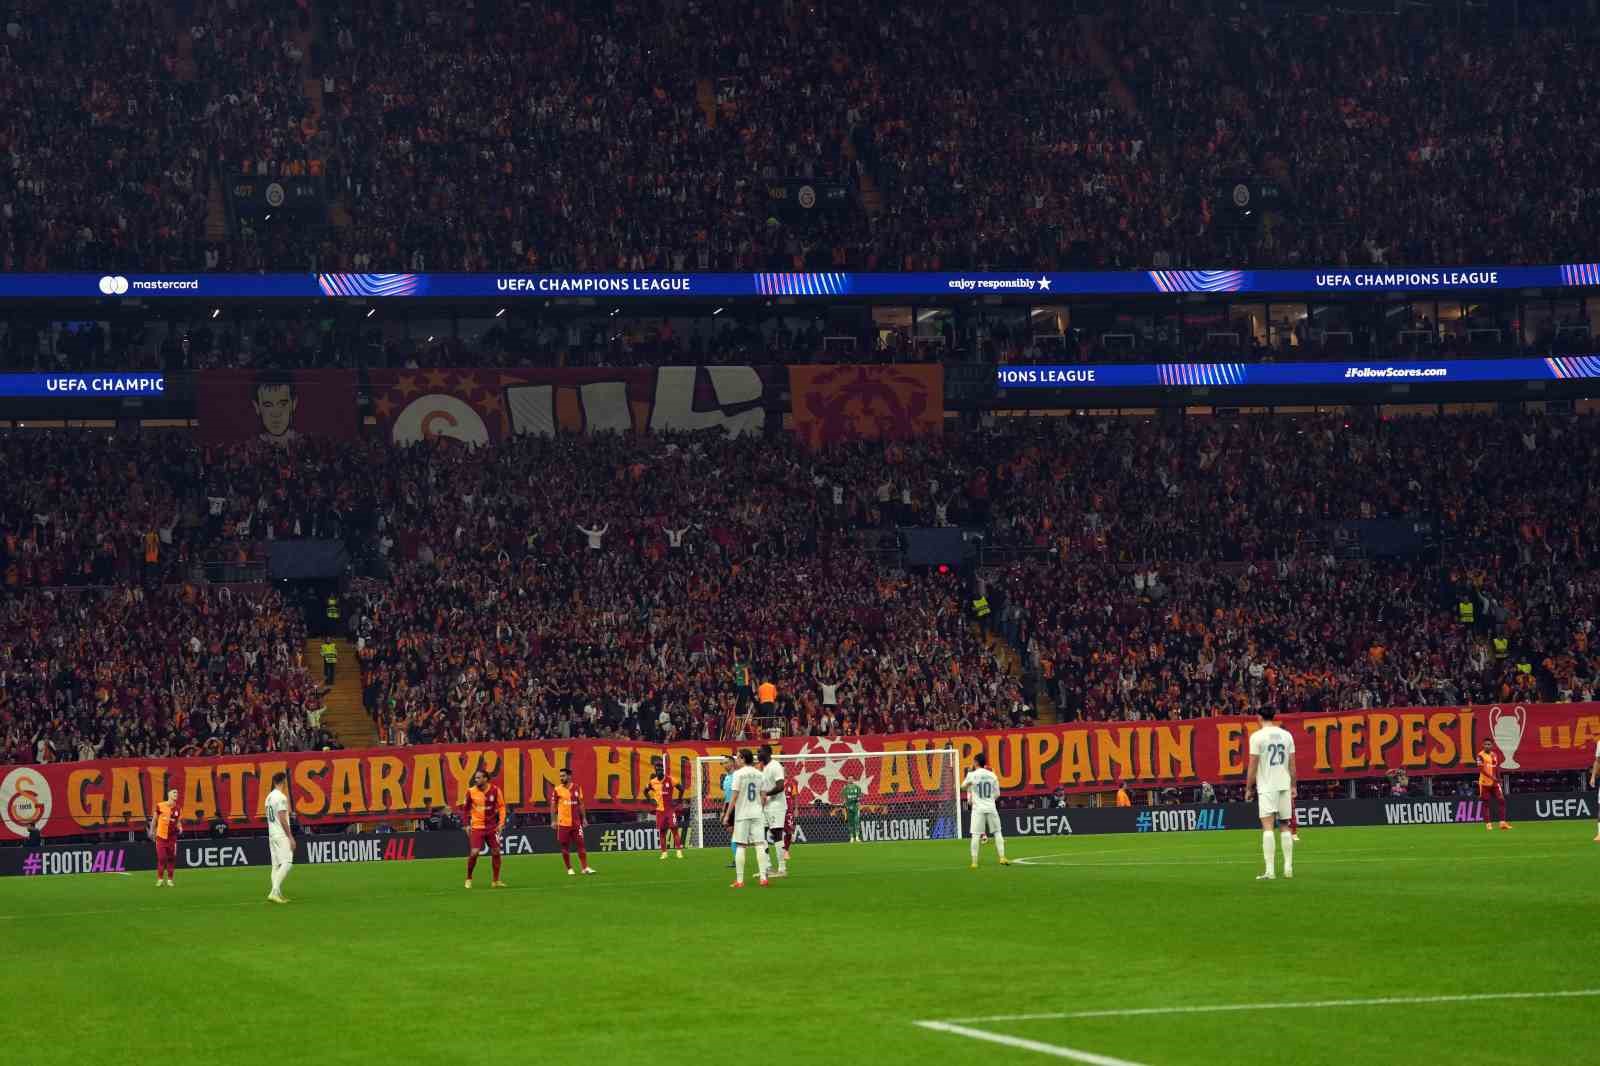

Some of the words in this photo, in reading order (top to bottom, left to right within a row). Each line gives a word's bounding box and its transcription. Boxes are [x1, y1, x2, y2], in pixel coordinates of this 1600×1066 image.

[133, 280, 198, 289] mastercard
[497, 279, 536, 291] UEFA
[539, 278, 629, 291] CHAMPIONS
[633, 278, 691, 290] LEAGUE
[948, 279, 976, 290] enjoy
[978, 278, 1036, 290] responsibly
[1316, 275, 1351, 287] UEFA
[1355, 273, 1440, 286] CHAMPIONS
[1443, 271, 1498, 285] LEAGUE
[46, 379, 88, 391] UEFA
[1040, 370, 1095, 382] LEAGUE
[879, 725, 1196, 794] AVRUPANIN
[1304, 708, 1476, 769] TEPESİ
[747, 781, 757, 802] 6
[976, 781, 991, 798] 10
[1295, 807, 1334, 825] EFA
[1385, 802, 1453, 824] WELCOME
[1455, 800, 1483, 822] ALL
[1536, 799, 1591, 817] UEFA
[861, 818, 930, 841] WELCOME
[1016, 815, 1073, 834] UEFA
[1136, 809, 1225, 832] #FOOTBALL
[185, 846, 248, 867] UEFA
[306, 839, 382, 863] WELCOME
[384, 838, 415, 861] ALL
[23, 849, 126, 875] #FOOTBALL
